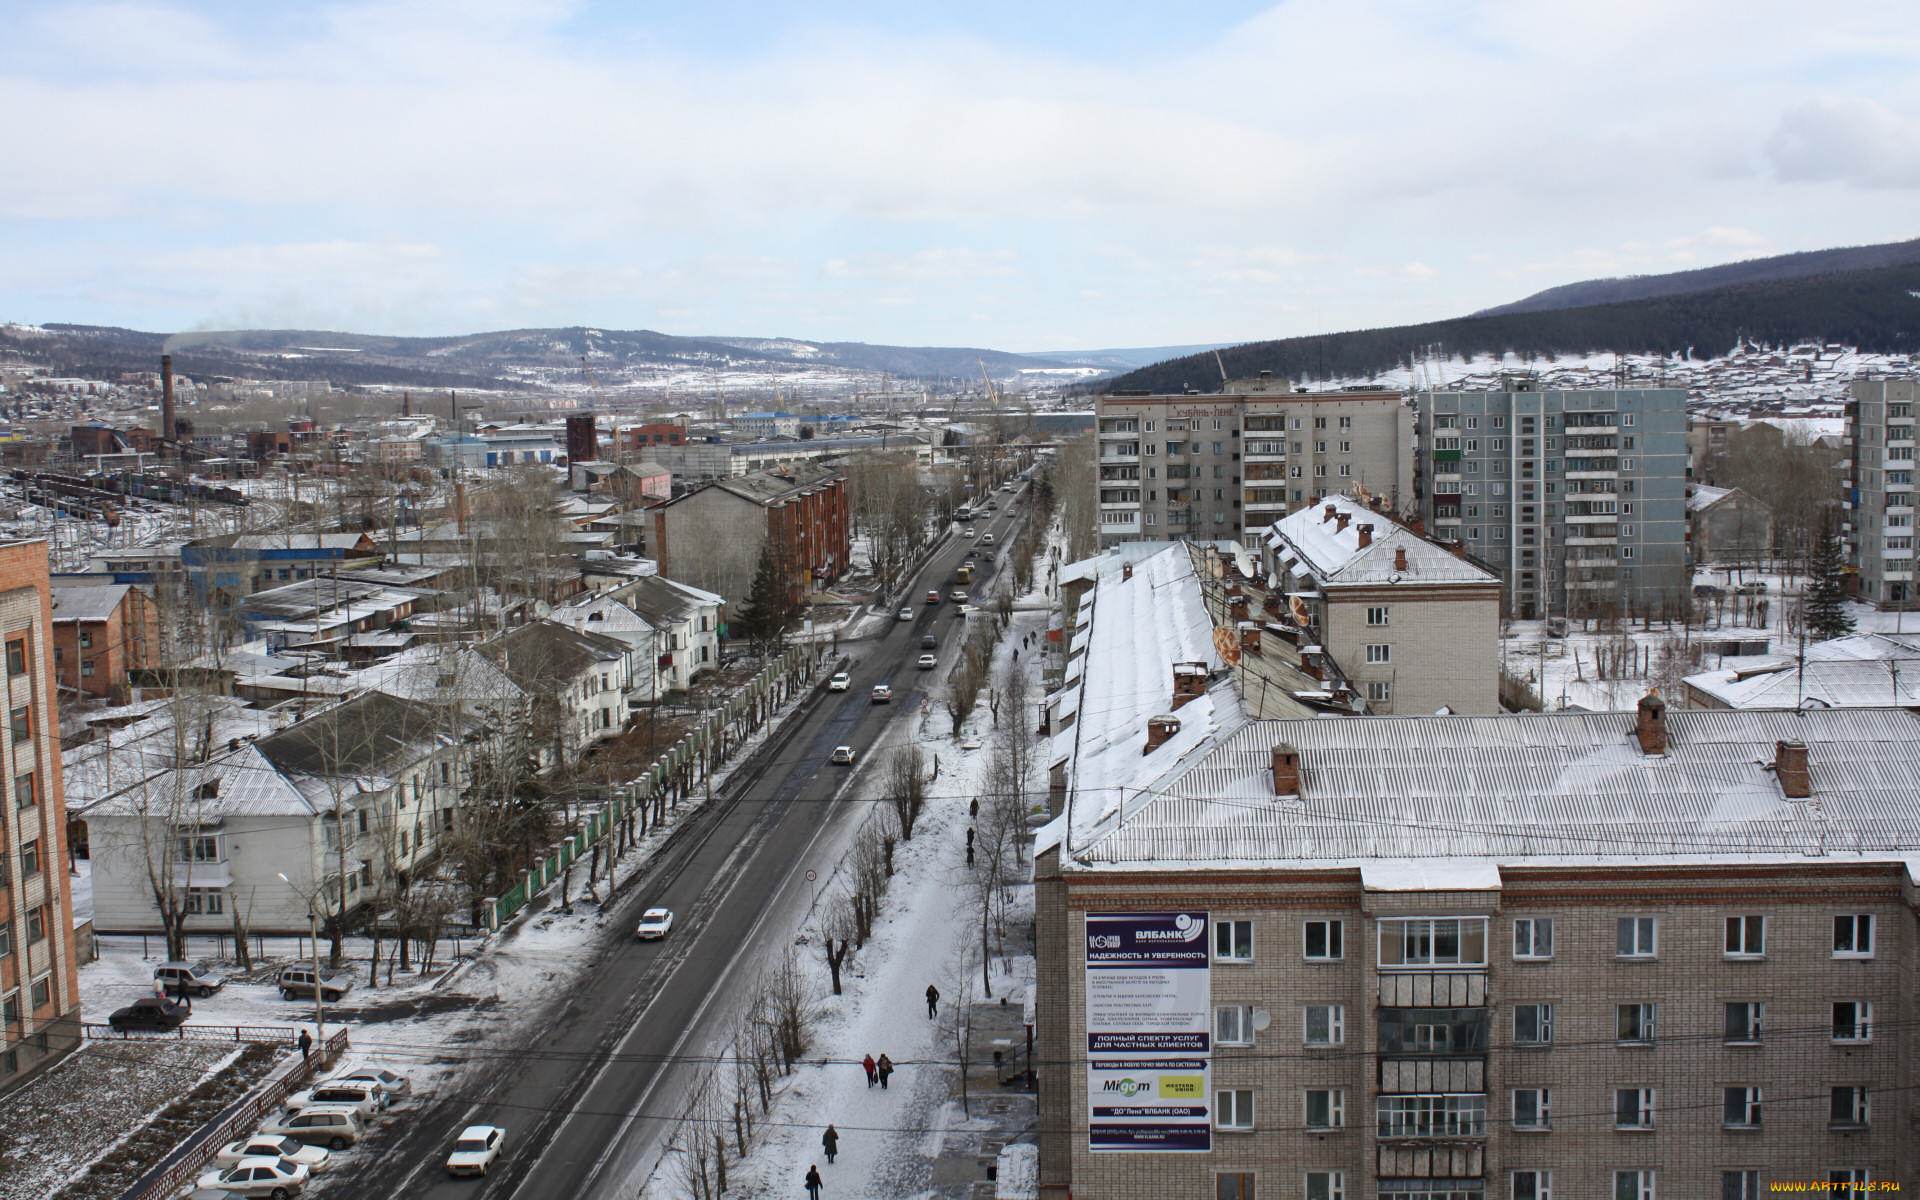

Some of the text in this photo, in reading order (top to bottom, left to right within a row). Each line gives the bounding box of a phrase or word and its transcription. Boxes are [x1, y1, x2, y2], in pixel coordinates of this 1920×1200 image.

[1136, 930, 1183, 938] ВЛБАНК
[1089, 952, 1142, 960] НАДЕЖНОСТЬ
[1152, 951, 1207, 959] УВЕРЕННОСТЬ
[1103, 1079, 1150, 1096] Migom
[1171, 1107, 1191, 1116] (ОАО)
